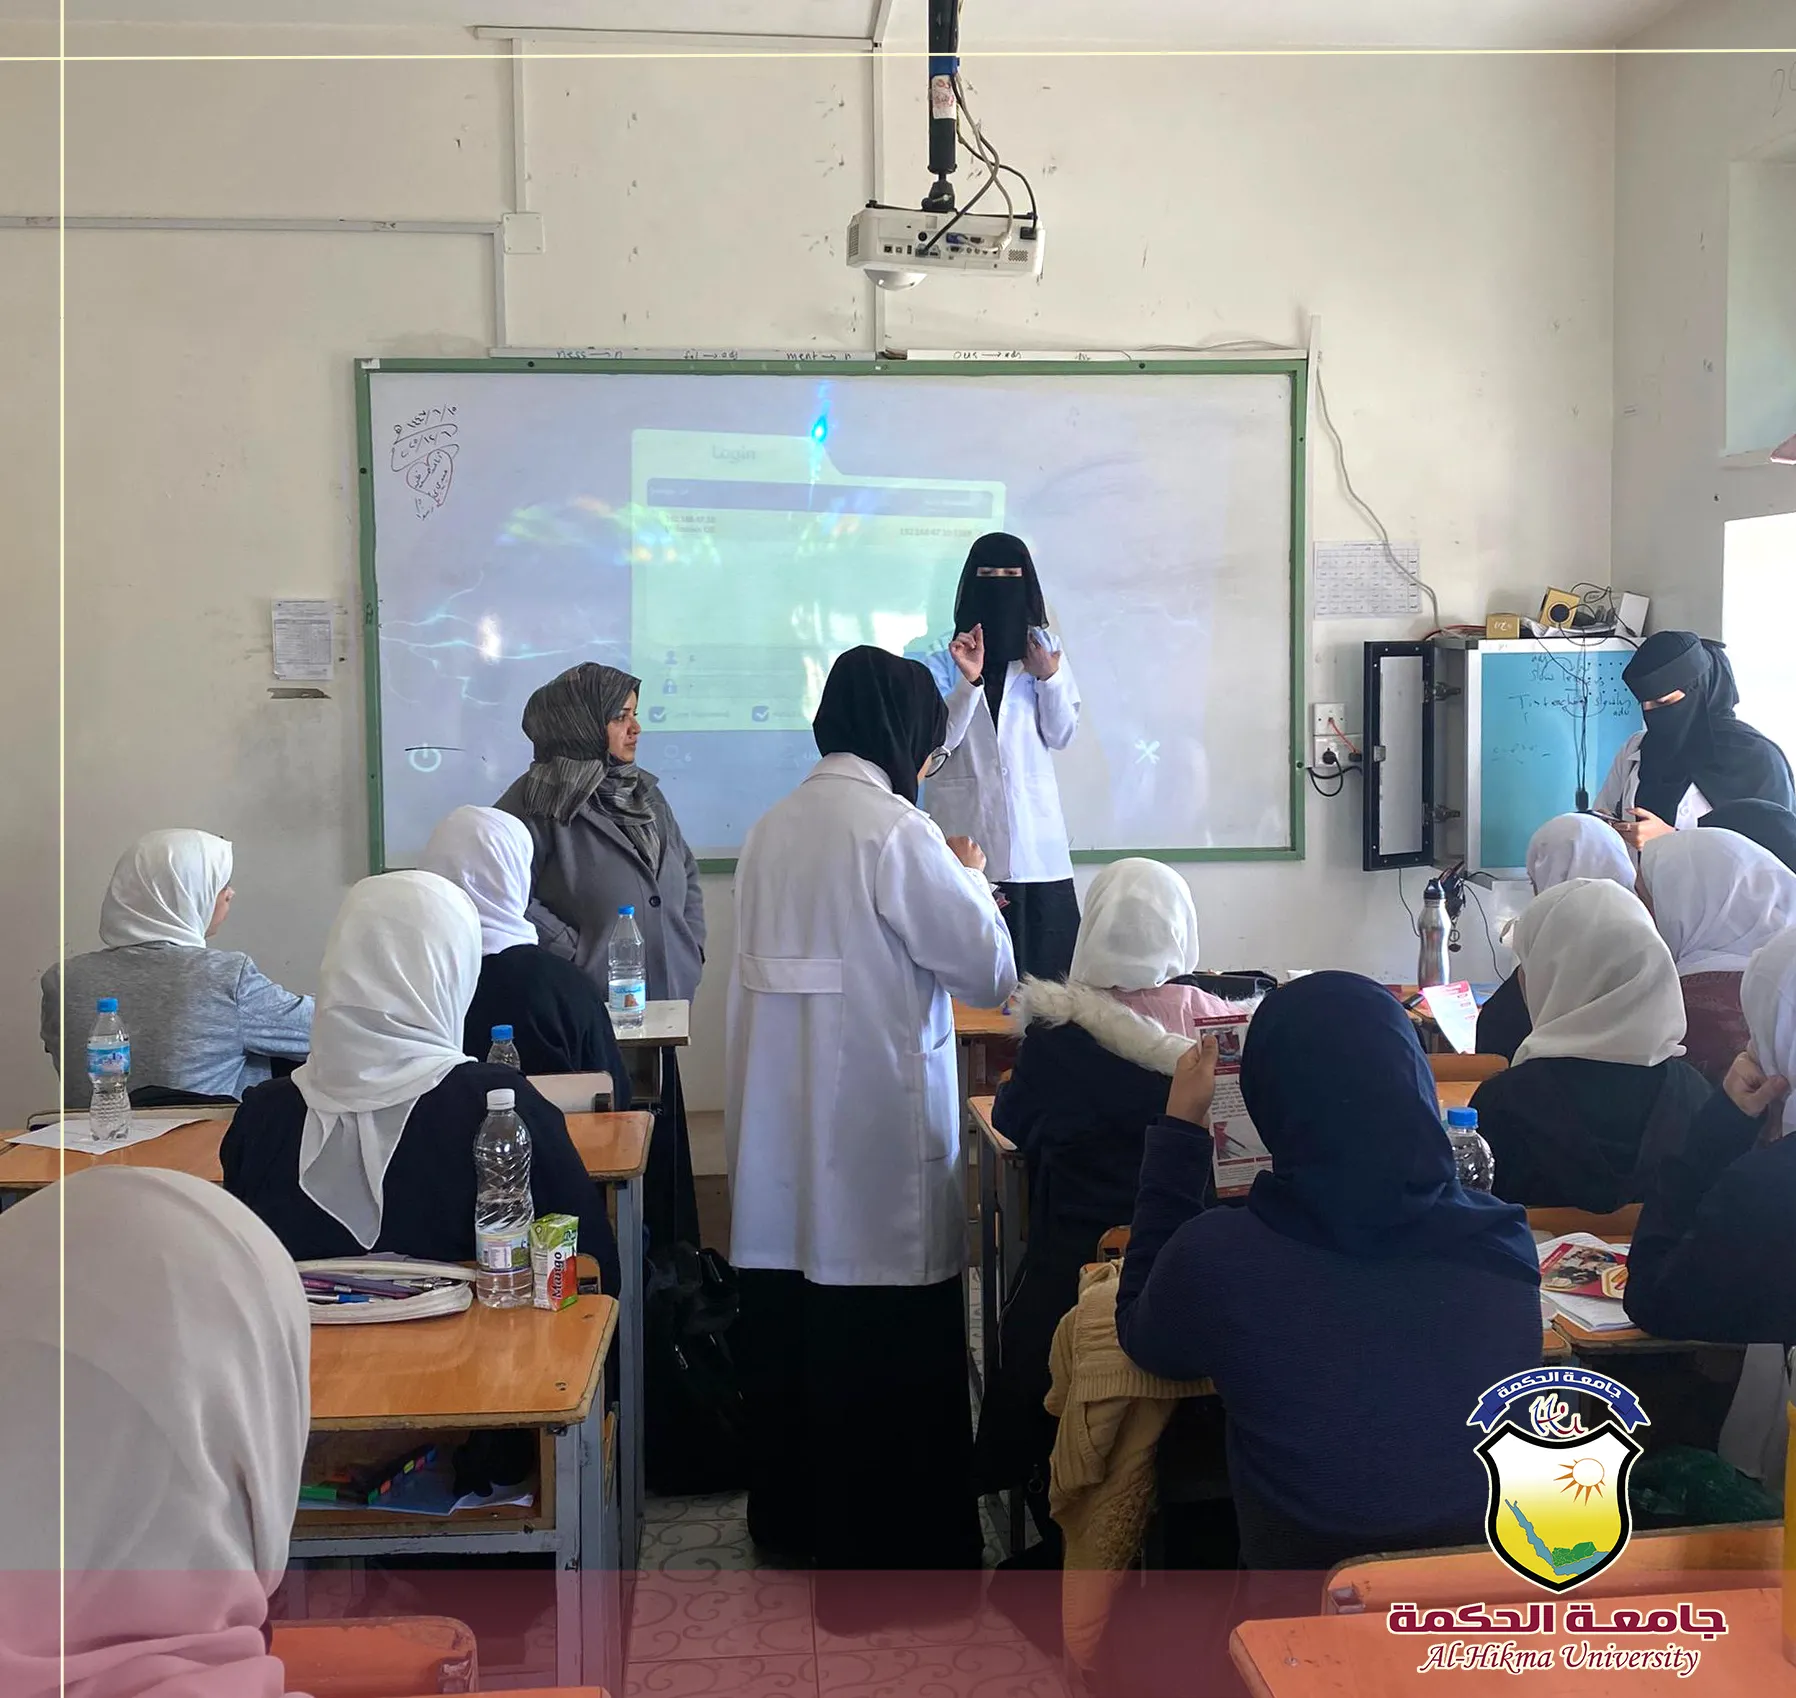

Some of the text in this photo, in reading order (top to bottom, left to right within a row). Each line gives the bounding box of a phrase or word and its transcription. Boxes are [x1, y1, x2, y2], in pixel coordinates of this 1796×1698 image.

[786, 350, 818, 361] ment
[711, 443, 756, 465] Login
[552, 1251, 564, 1298] Mango
